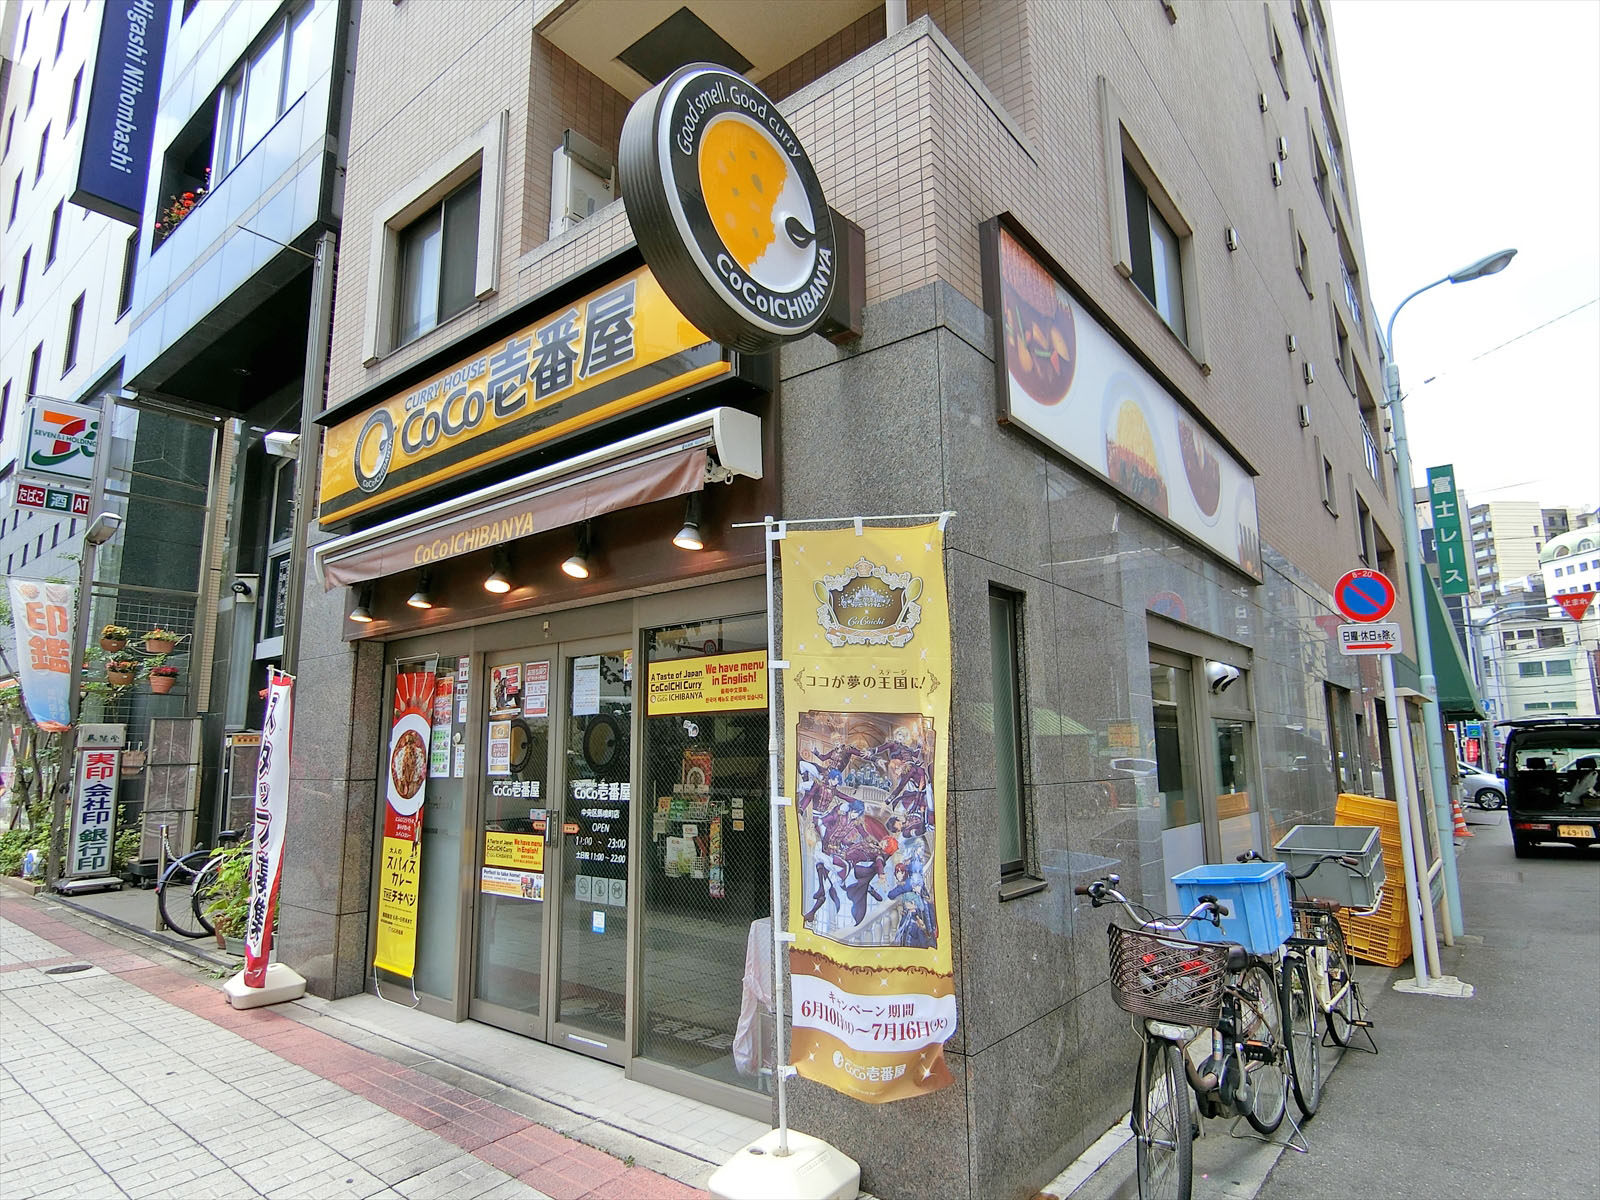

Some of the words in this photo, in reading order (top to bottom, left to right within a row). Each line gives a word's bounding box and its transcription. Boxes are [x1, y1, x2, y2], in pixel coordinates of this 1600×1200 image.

[127, 0, 155, 65] Higashi
[110, 62, 145, 174] Nihombashi
[677, 99, 700, 157] Good
[694, 81, 730, 115] smell.
[730, 85, 768, 121] Good
[769, 116, 802, 159] curry
[716, 247, 832, 320] CoCoICHIBANYA
[401, 279, 637, 455] CoCo壱番屋
[405, 380, 441, 412] CURRY
[442, 357, 488, 392] HOUSE
[66, 436, 97, 447] HOLDING
[18, 487, 45, 504] たばこ
[50, 493, 69, 508] 酒
[74, 498, 89, 512] AT
[1431, 476, 1465, 583] 富士レース
[1562, 597, 1589, 607] 止まれ
[26, 601, 71, 674] 印鑑
[656, 672, 675, 681] Taste
[675, 671, 683, 679] of
[683, 669, 703, 679] Japan
[705, 664, 717, 675] We
[718, 662, 739, 673] have
[740, 661, 764, 671] menu
[712, 676, 720, 686] in
[721, 671, 757, 685] English!
[805, 674, 927, 690] ココが夢の王国に!
[650, 681, 683, 692] CoCoICHI
[683, 681, 703, 690] Curry
[668, 692, 703, 702] ICHIBANYA
[492, 780, 541, 798] CoCo壱番屋
[592, 822, 611, 833] OPEN
[575, 836, 593, 846] 11:00
[607, 838, 627, 849] 23:00
[389, 847, 402, 855] 大人の
[590, 852, 605, 861] 11:00
[610, 854, 626, 864] 22:00
[386, 856, 416, 874] スパイス
[391, 872, 412, 887] カレー
[844, 1061, 907, 1081] CoCo壱番屋
